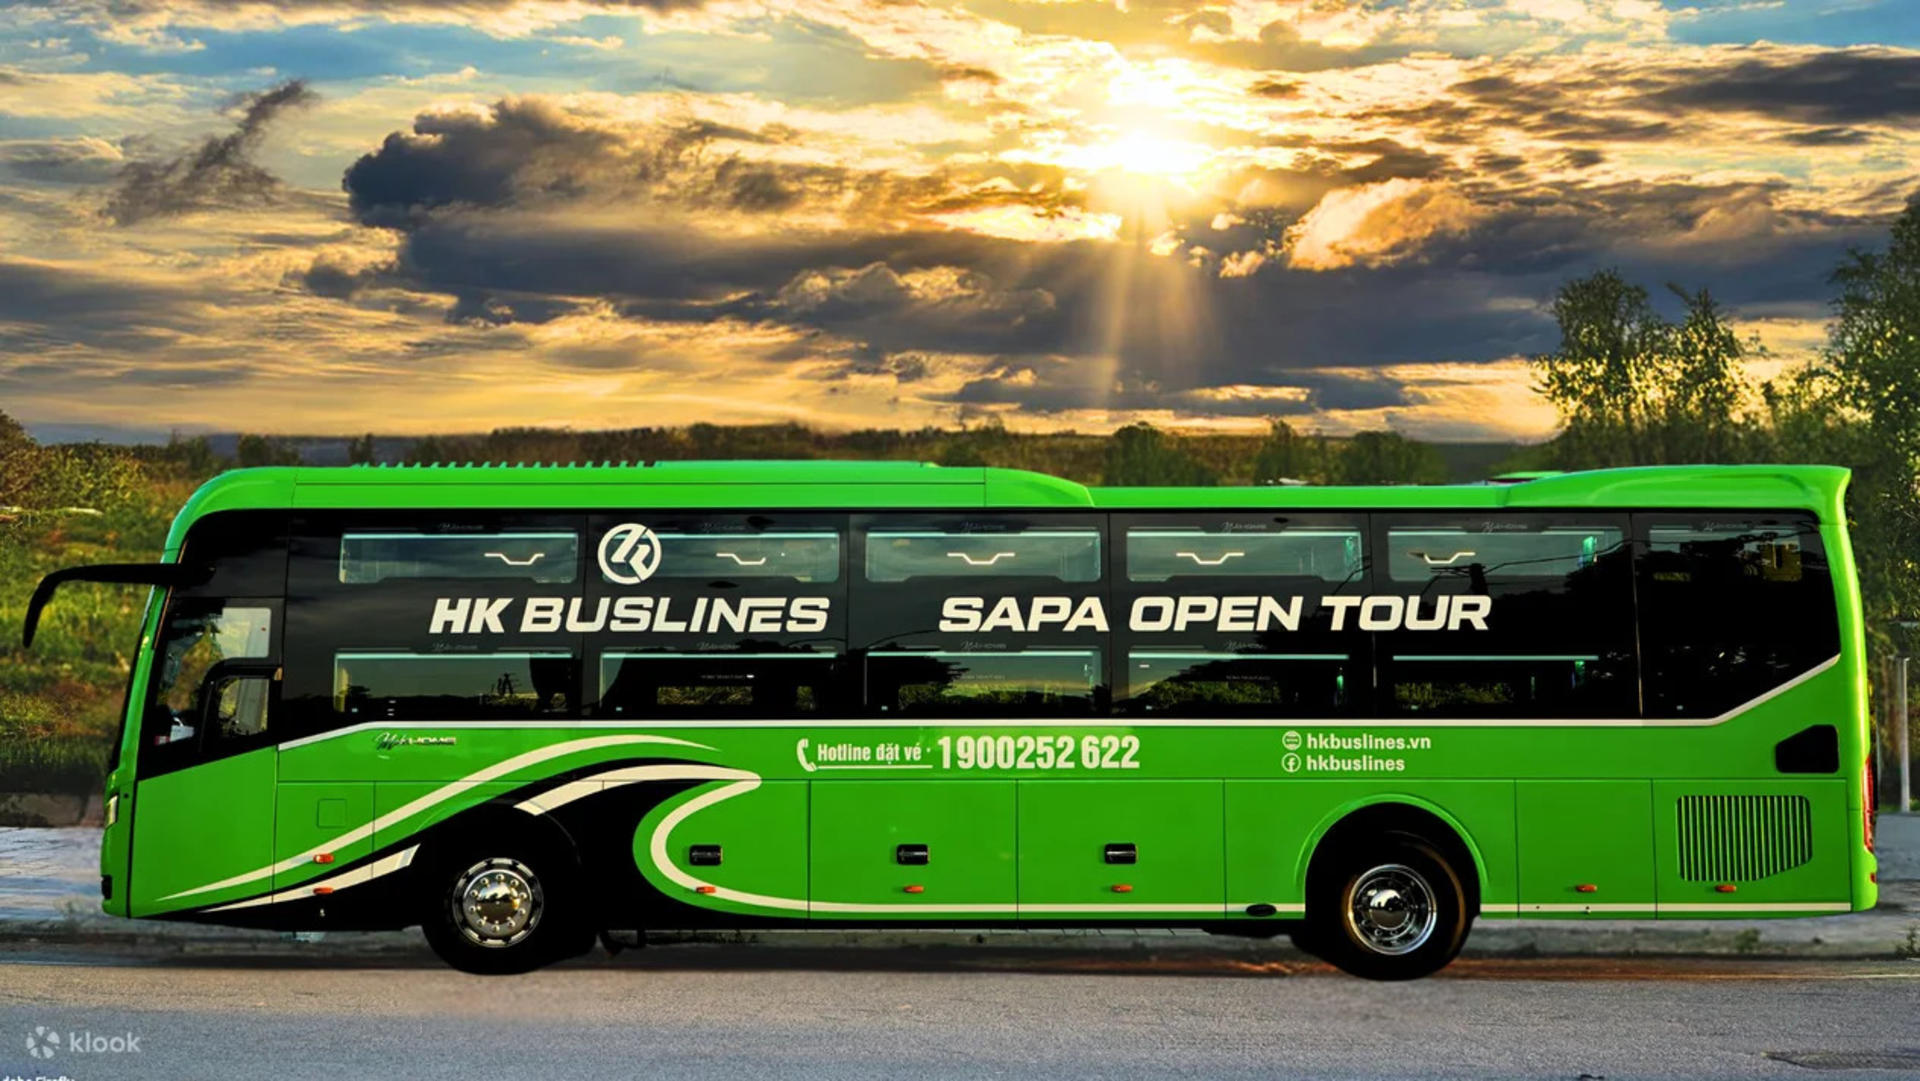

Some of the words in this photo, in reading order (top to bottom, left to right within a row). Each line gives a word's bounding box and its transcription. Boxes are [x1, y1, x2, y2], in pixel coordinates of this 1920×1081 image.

[429, 598, 513, 634] HK
[519, 597, 830, 634] BUSLINES
[938, 596, 1110, 632] SAPA
[1129, 596, 1304, 632] OPEN
[1321, 595, 1492, 631] TOUR
[817, 743, 872, 762] Hotline
[875, 743, 900, 765] đặt
[937, 735, 1076, 769] 1900252
[1080, 735, 1141, 769] 622
[1306, 733, 1432, 750] hkbuslines.vn
[1306, 755, 1406, 772] hkbuslines
